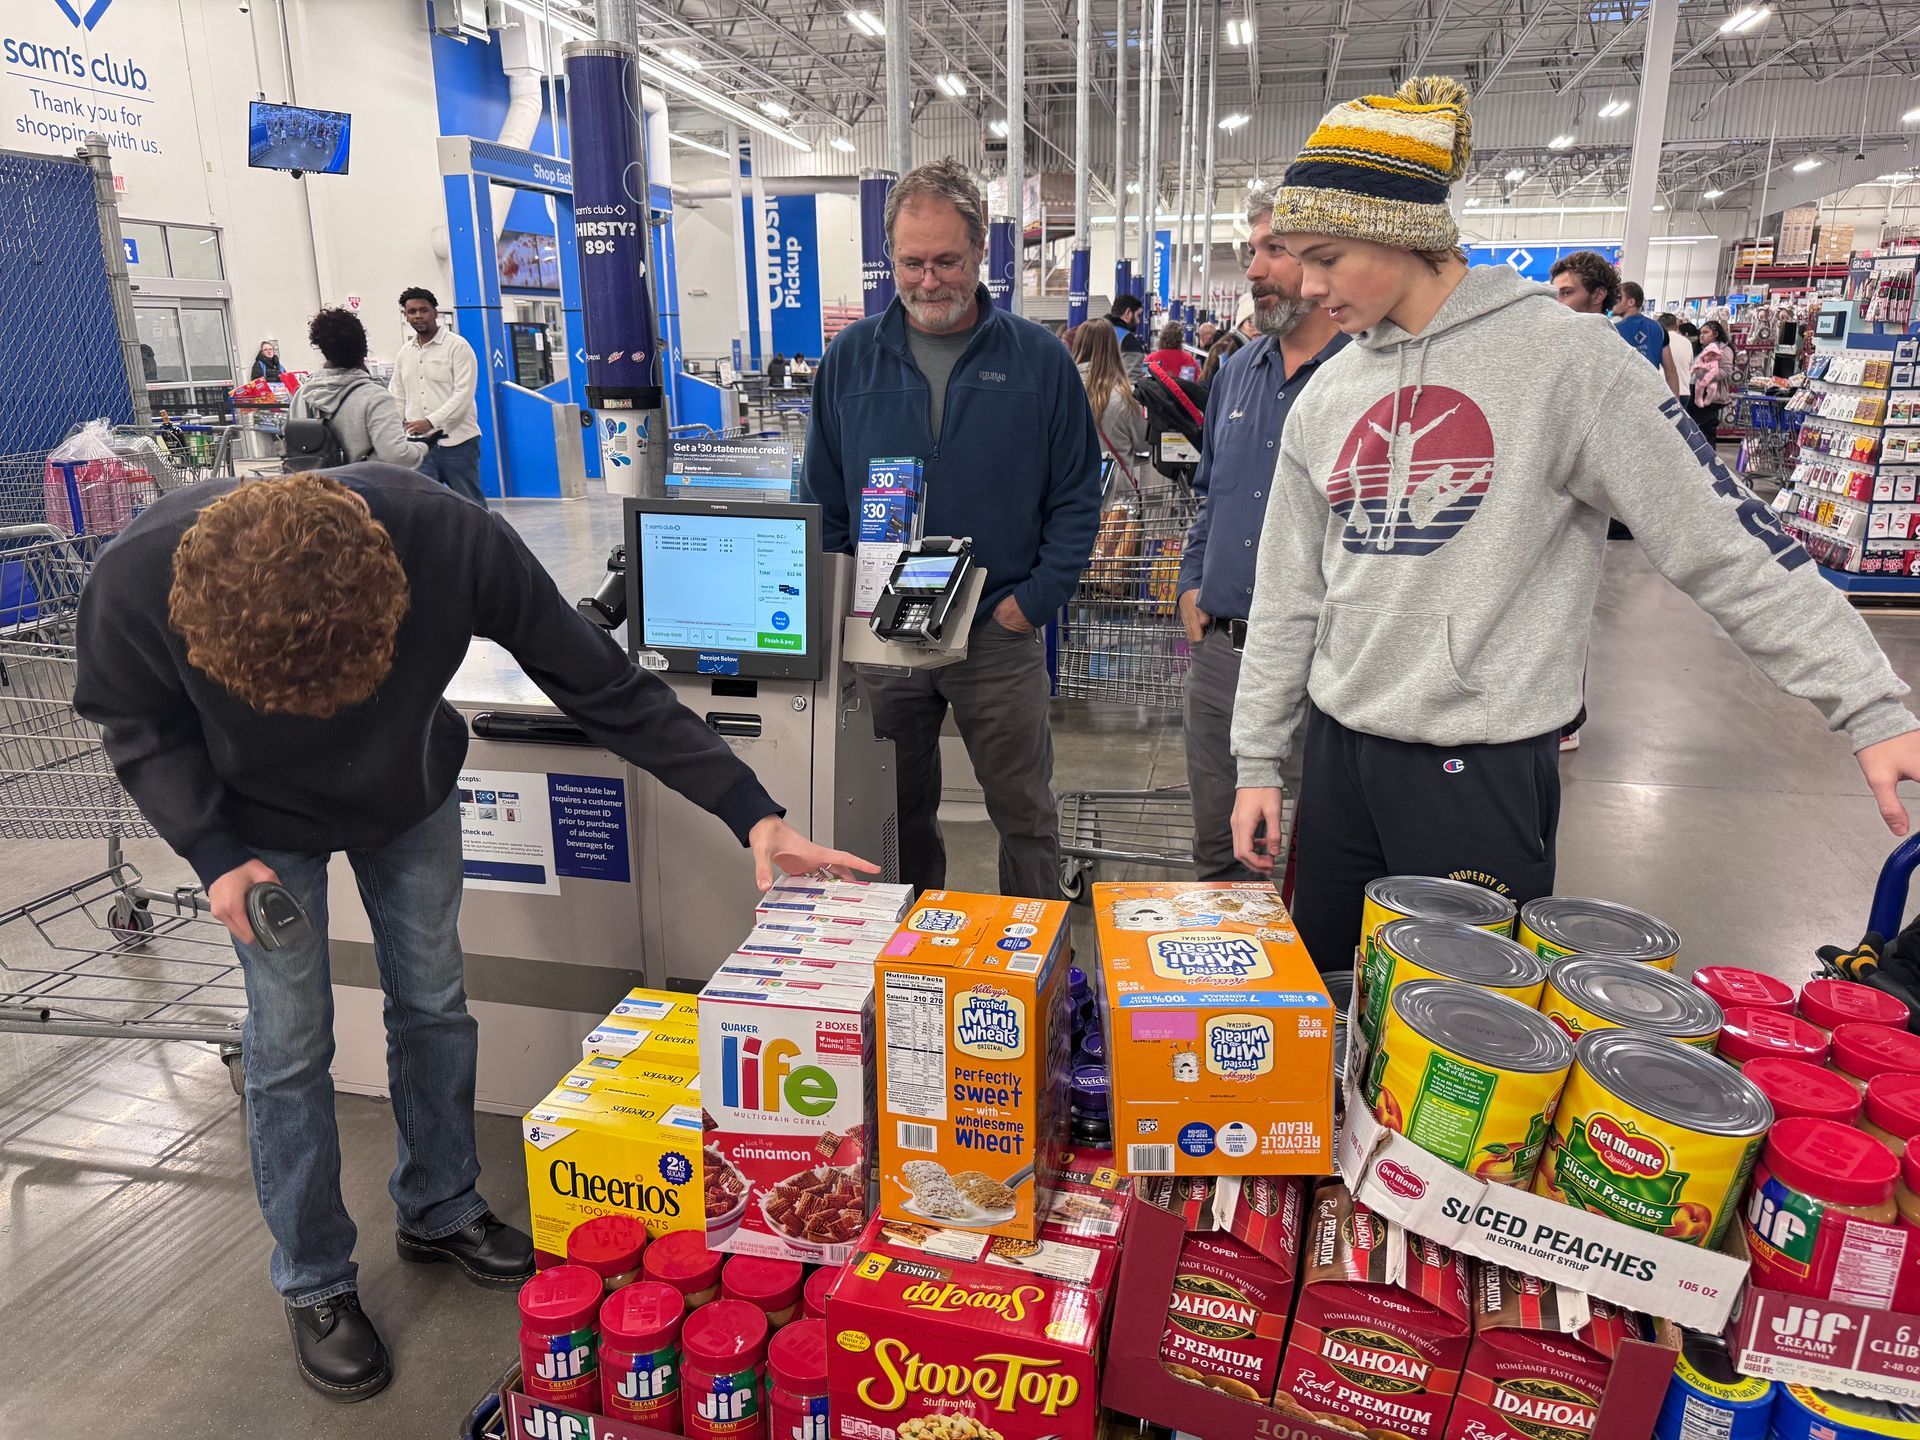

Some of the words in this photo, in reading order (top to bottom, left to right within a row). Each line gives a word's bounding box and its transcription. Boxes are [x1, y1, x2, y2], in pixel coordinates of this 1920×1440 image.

[3, 38, 85, 78] sam's
[91, 53, 148, 91] club
[29, 88, 84, 118] Thank
[87, 104, 118, 126] you
[120, 106, 142, 127] for
[140, 138, 162, 155] us.
[113, 175, 125, 192] XIT
[533, 165, 556, 185] Shop
[593, 204, 613, 216] club
[575, 221, 637, 238] HIRSTY?
[585, 240, 616, 256] 89¢
[784, 236, 802, 309] Pickup
[673, 443, 688, 452] Get
[697, 444, 712, 453] $30
[713, 445, 757, 454] statement
[871, 472, 894, 488] $30
[863, 503, 886, 519] $30
[700, 654, 722, 663] Receipt
[555, 784, 582, 794] Indiana
[583, 787, 602, 795] state
[603, 787, 617, 796] law
[551, 796, 581, 805] requires
[588, 798, 623, 807] customer
[573, 808, 602, 817] present
[558, 817, 576, 827] prior
[586, 820, 620, 829] purchase
[578, 829, 610, 839] alcoholic
[566, 839, 603, 850] beverages
[604, 842, 614, 850] for
[575, 851, 608, 861] carryout.
[1448, 870, 1497, 887] PROPERTY
[1496, 883, 1510, 894] OF
[1160, 940, 1255, 956] Wheats
[1170, 951, 1251, 969] Mini
[886, 972, 920, 980] Nutrition
[922, 975, 943, 983] Facts
[1185, 965, 1248, 976] Frosted
[971, 982, 1010, 998] Kellogg's
[913, 995, 927, 1003] 210
[929, 997, 943, 1005] 270
[969, 997, 1008, 1011] Frosted
[720, 1022, 759, 1034] QUAKER
[815, 1021, 823, 1029] 2
[825, 1021, 859, 1032] BOXES
[962, 1010, 1016, 1030] Mini
[1298, 1019, 1311, 1027] OZ
[1310, 1019, 1322, 1027] 55
[959, 1024, 1019, 1046] Wheats
[1212, 1027, 1268, 1047] Wheats
[1298, 1030, 1322, 1038] BAGS
[1321, 1030, 1328, 1038] 2
[819, 1042, 844, 1051] Healthy
[976, 1043, 1003, 1053] ORIGINAL
[1214, 1040, 1263, 1061] Mini
[1222, 1059, 1258, 1071] Frosted
[1445, 1060, 1466, 1072] Picked
[721, 1035, 838, 1117] life
[1457, 1071, 1484, 1086] Ripeness
[953, 1084, 1022, 1108] sweet
[610, 1104, 655, 1120] Cheerios
[733, 1111, 790, 1124] MULTIGRAIN
[793, 1116, 827, 1127] CEREAL
[976, 1106, 999, 1118] with
[955, 1114, 1025, 1133] wholesome
[1269, 1121, 1313, 1135] READY
[1260, 1134, 1322, 1149] RECYCLE
[1589, 1122, 1612, 1147] Del
[1610, 1139, 1663, 1172] Monte
[732, 1144, 811, 1162] cinnamon
[1603, 1149, 1635, 1172] Quality
[665, 1156, 686, 1172] 2g
[666, 1170, 686, 1179] SUGAR
[1101, 1171, 1111, 1181] 6
[549, 1159, 681, 1217] Cheerios
[1563, 1155, 1598, 1191] Sliced
[1601, 1184, 1665, 1220] Peaches
[578, 1204, 611, 1218] 100%
[637, 1216, 669, 1230] OATS
[1747, 1188, 1806, 1250] Jif
[1354, 1211, 1371, 1250] IDAHOAN
[1847, 1221, 1883, 1235] Nutrition
[1197, 1240, 1211, 1251] TO
[1211, 1245, 1239, 1259] OPEN
[1320, 1219, 1337, 1266] PREMIUM
[1844, 1240, 1873, 1251] Calories
[1884, 1246, 1902, 1256] 190
[1485, 1231, 1497, 1241] IN
[1497, 1235, 1527, 1256] EXTRA
[1527, 1243, 1558, 1265] LIGHT
[1558, 1254, 1590, 1273] SYRUP
[1532, 1223, 1659, 1283] PEACHES
[866, 1263, 879, 1275] 6
[893, 1260, 942, 1280] TURKEY
[1202, 1263, 1223, 1277] TASTE
[1224, 1271, 1235, 1280] IN
[1235, 1276, 1268, 1301] MINUTES
[1677, 1280, 1700, 1293] 105
[1700, 1285, 1720, 1300] OZ
[1367, 1292, 1381, 1304] TO
[1382, 1299, 1411, 1314] OPEN
[1771, 1305, 1852, 1343] Jif
[1323, 1311, 1371, 1323] HOMEMADE
[1372, 1317, 1397, 1334] TASTE
[1407, 1329, 1443, 1357] MINUTES
[1894, 1325, 1912, 1342] 6
[1173, 1332, 1264, 1371] PREMIUM
[1540, 1342, 1555, 1354] TO
[1556, 1347, 1586, 1363] OPEN
[1773, 1334, 1838, 1355] CREAMY
[535, 1344, 590, 1379] Jif
[1321, 1337, 1429, 1381] IDAHOAN
[1743, 1362, 1761, 1371] USED
[1745, 1353, 1764, 1363] BEST
[1191, 1357, 1261, 1382] POTATOES
[1495, 1361, 1549, 1374] HOMEMADE
[1548, 1366, 1575, 1384] TASTE
[548, 1380, 577, 1391] CREAMY
[616, 1364, 673, 1399] Jif
[1685, 1372, 1713, 1393] Chunk
[1714, 1385, 1737, 1399] Light
[629, 1400, 660, 1410] CREAMY
[696, 1387, 752, 1420] Jif
[922, 1396, 959, 1412] Stuffing
[959, 1399, 977, 1410] Mix
[1298, 1368, 1337, 1393] Real
[1337, 1386, 1433, 1426] PREMIUM
[1292, 1384, 1351, 1413] MASHED
[1354, 1409, 1429, 1437] POTATOES
[1687, 1395, 1714, 1414] Nutrition
[1714, 1409, 1733, 1418] Facts
[523, 1408, 584, 1440] Jif
[1716, 1428, 1729, 1437] 90
